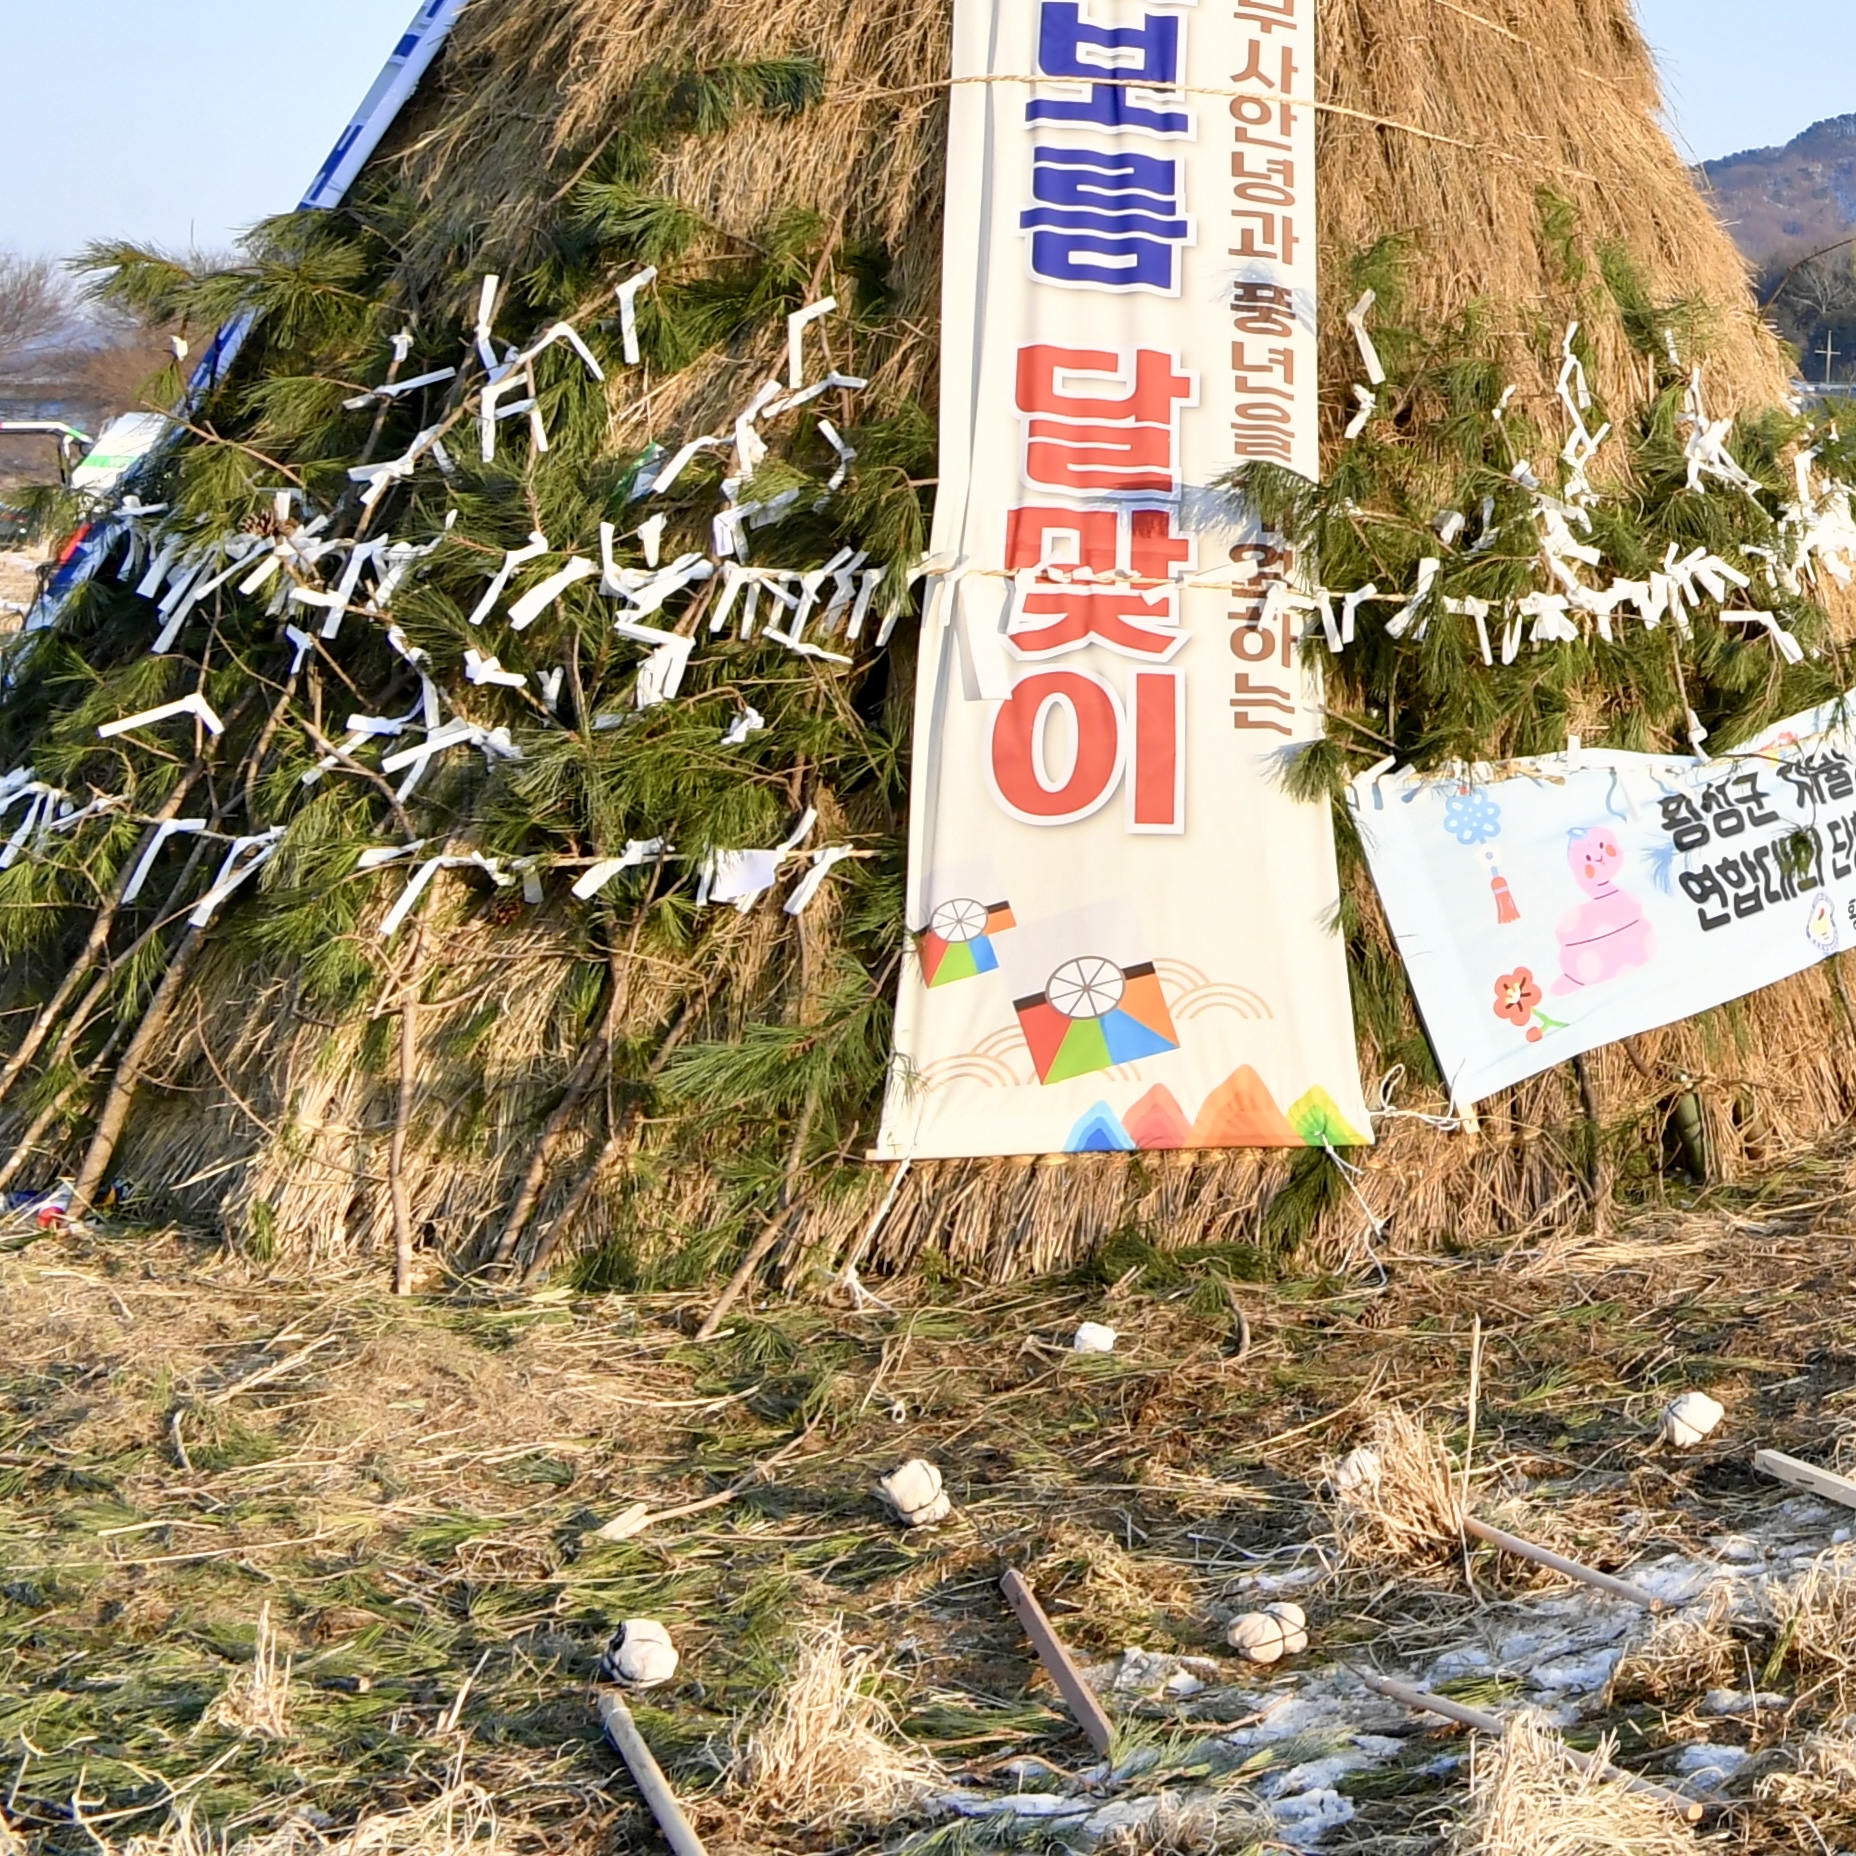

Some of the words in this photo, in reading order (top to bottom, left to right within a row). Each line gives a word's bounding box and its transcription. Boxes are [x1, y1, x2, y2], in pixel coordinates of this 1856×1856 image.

[1230, 280, 1297, 463] 풍년을
[991, 344, 1191, 825] 달맞이
[1657, 772, 1780, 853] 횡성군
